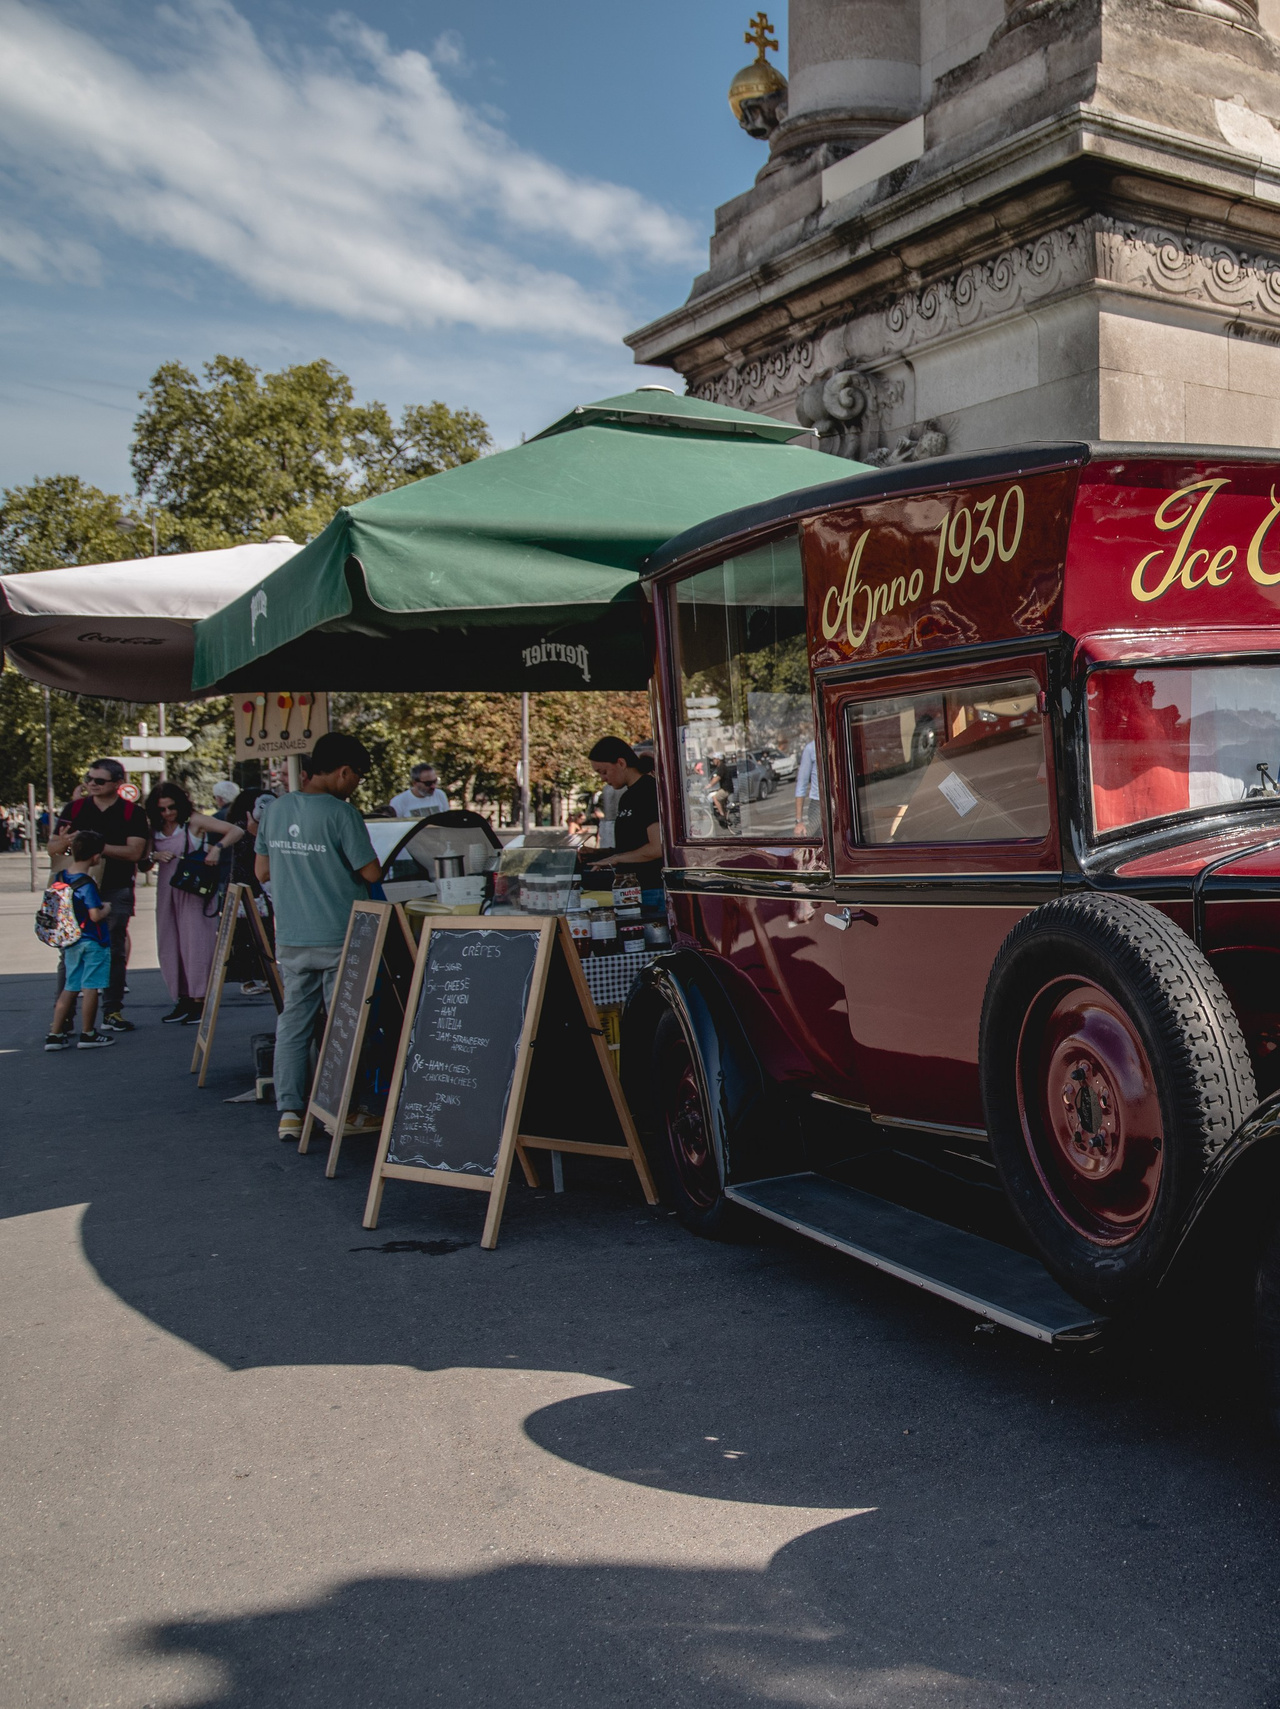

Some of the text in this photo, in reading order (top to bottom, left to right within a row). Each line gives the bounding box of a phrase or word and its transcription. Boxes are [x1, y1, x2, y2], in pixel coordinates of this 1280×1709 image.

[1131, 478, 1238, 603] Ice
[822, 484, 1025, 648] Anno 1930
[257, 739, 307, 752] ARTISANALES
[462, 942, 501, 958] CRÊPES
[435, 1093, 461, 1106] DRINKS
